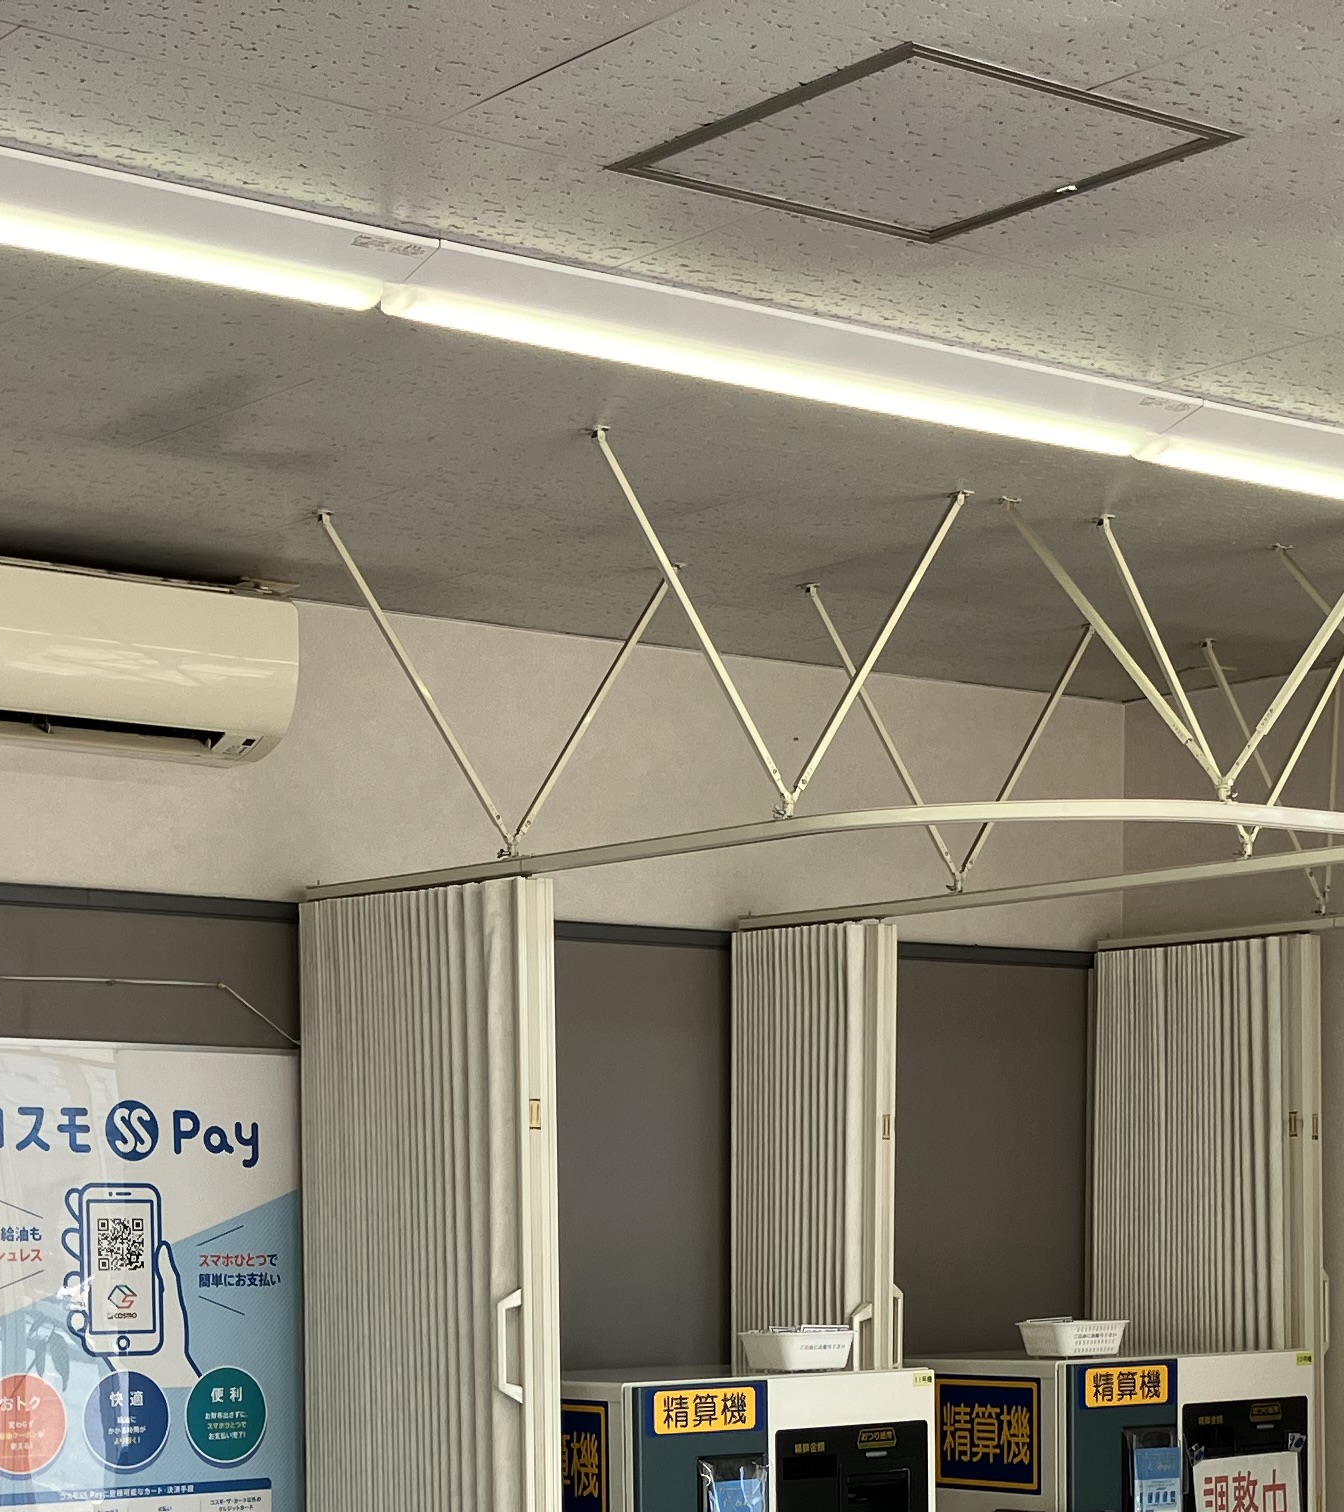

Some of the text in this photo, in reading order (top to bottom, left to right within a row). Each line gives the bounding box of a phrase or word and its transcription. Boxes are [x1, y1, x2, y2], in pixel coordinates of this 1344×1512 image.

[172, 1109, 259, 1168] Pay
[0, 1226, 43, 1243] 給油も
[198, 1252, 278, 1268] スマホひとつで
[197, 1273, 281, 1289] 簡単にお支払い
[210, 1386, 243, 1403] 便利
[1092, 1369, 1162, 1404] 精算機
[0, 1396, 41, 1411] おトク
[109, 1390, 144, 1408] 快適
[662, 1390, 748, 1429] 精算機
[942, 1400, 1031, 1466] 精算機
[561, 1430, 600, 1499] 機
